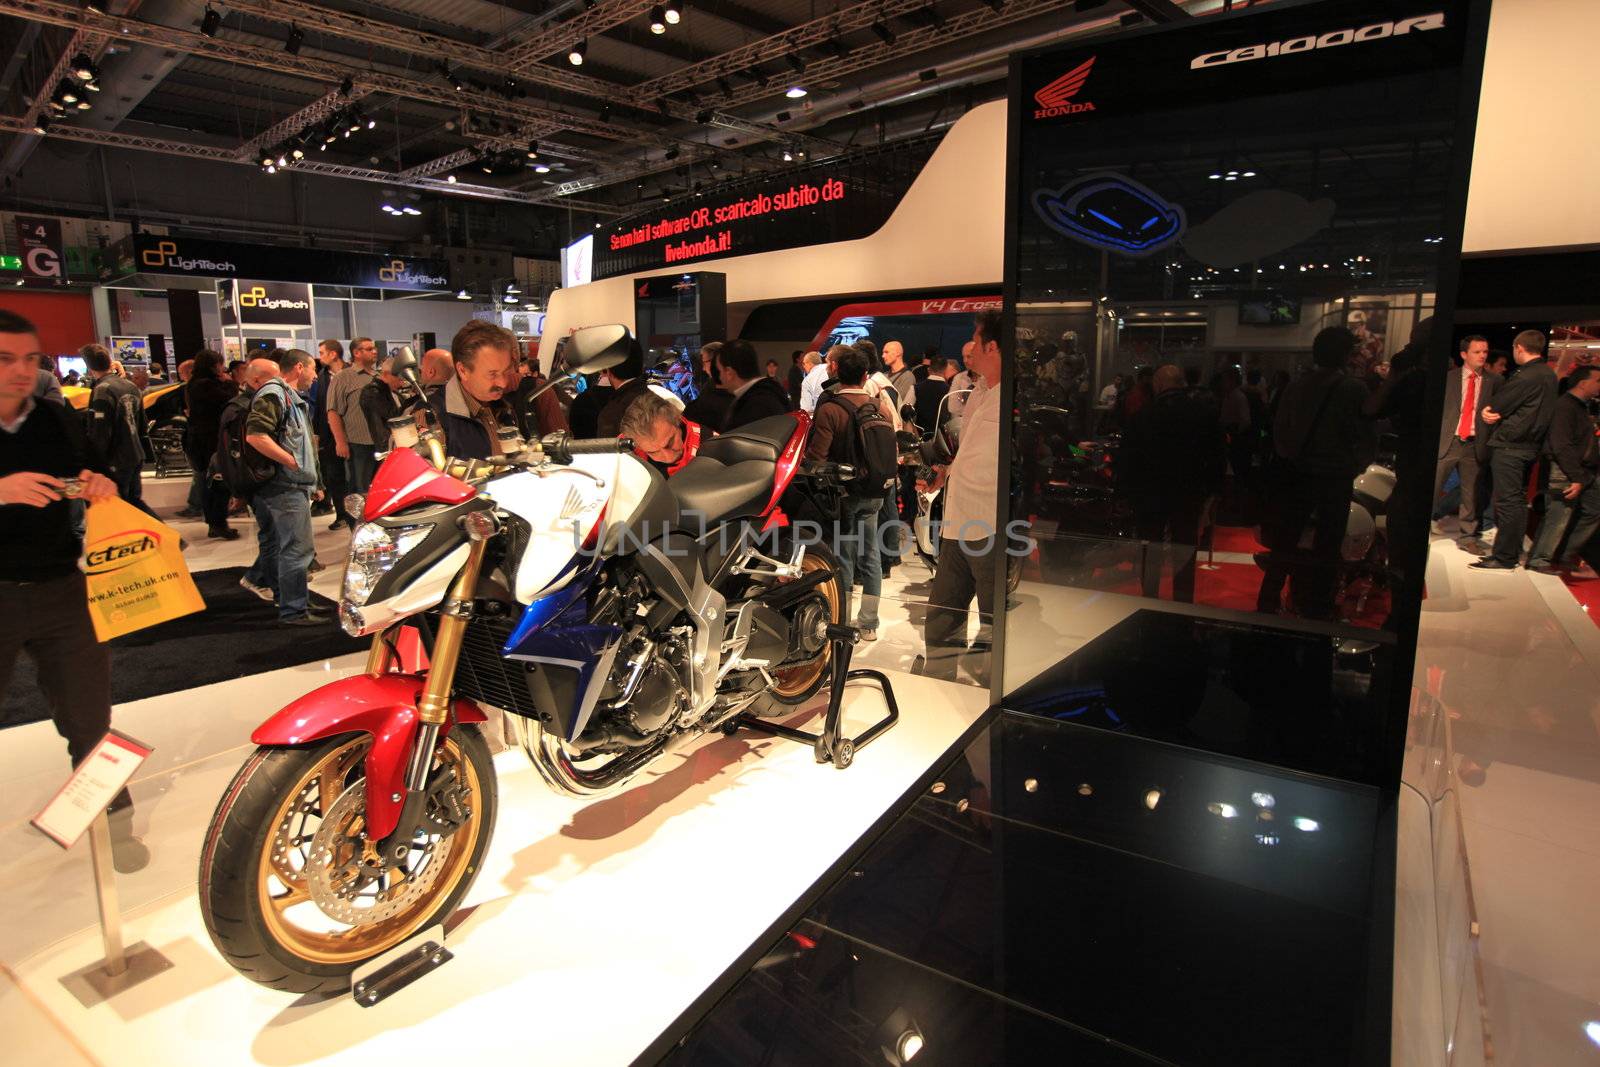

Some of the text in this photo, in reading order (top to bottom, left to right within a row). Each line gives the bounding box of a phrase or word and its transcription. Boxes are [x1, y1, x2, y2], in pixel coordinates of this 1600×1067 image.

[1190, 12, 1446, 70] CB1000R
[1034, 102, 1096, 119] HONDA
[652, 217, 691, 240] software
[714, 193, 771, 223] scaricalo
[773, 184, 819, 211] subito
[822, 178, 844, 202] da
[35, 226, 47, 238] 4
[665, 230, 732, 262] livehonda.it!
[27, 247, 61, 277] G
[921, 301, 946, 312] V4
